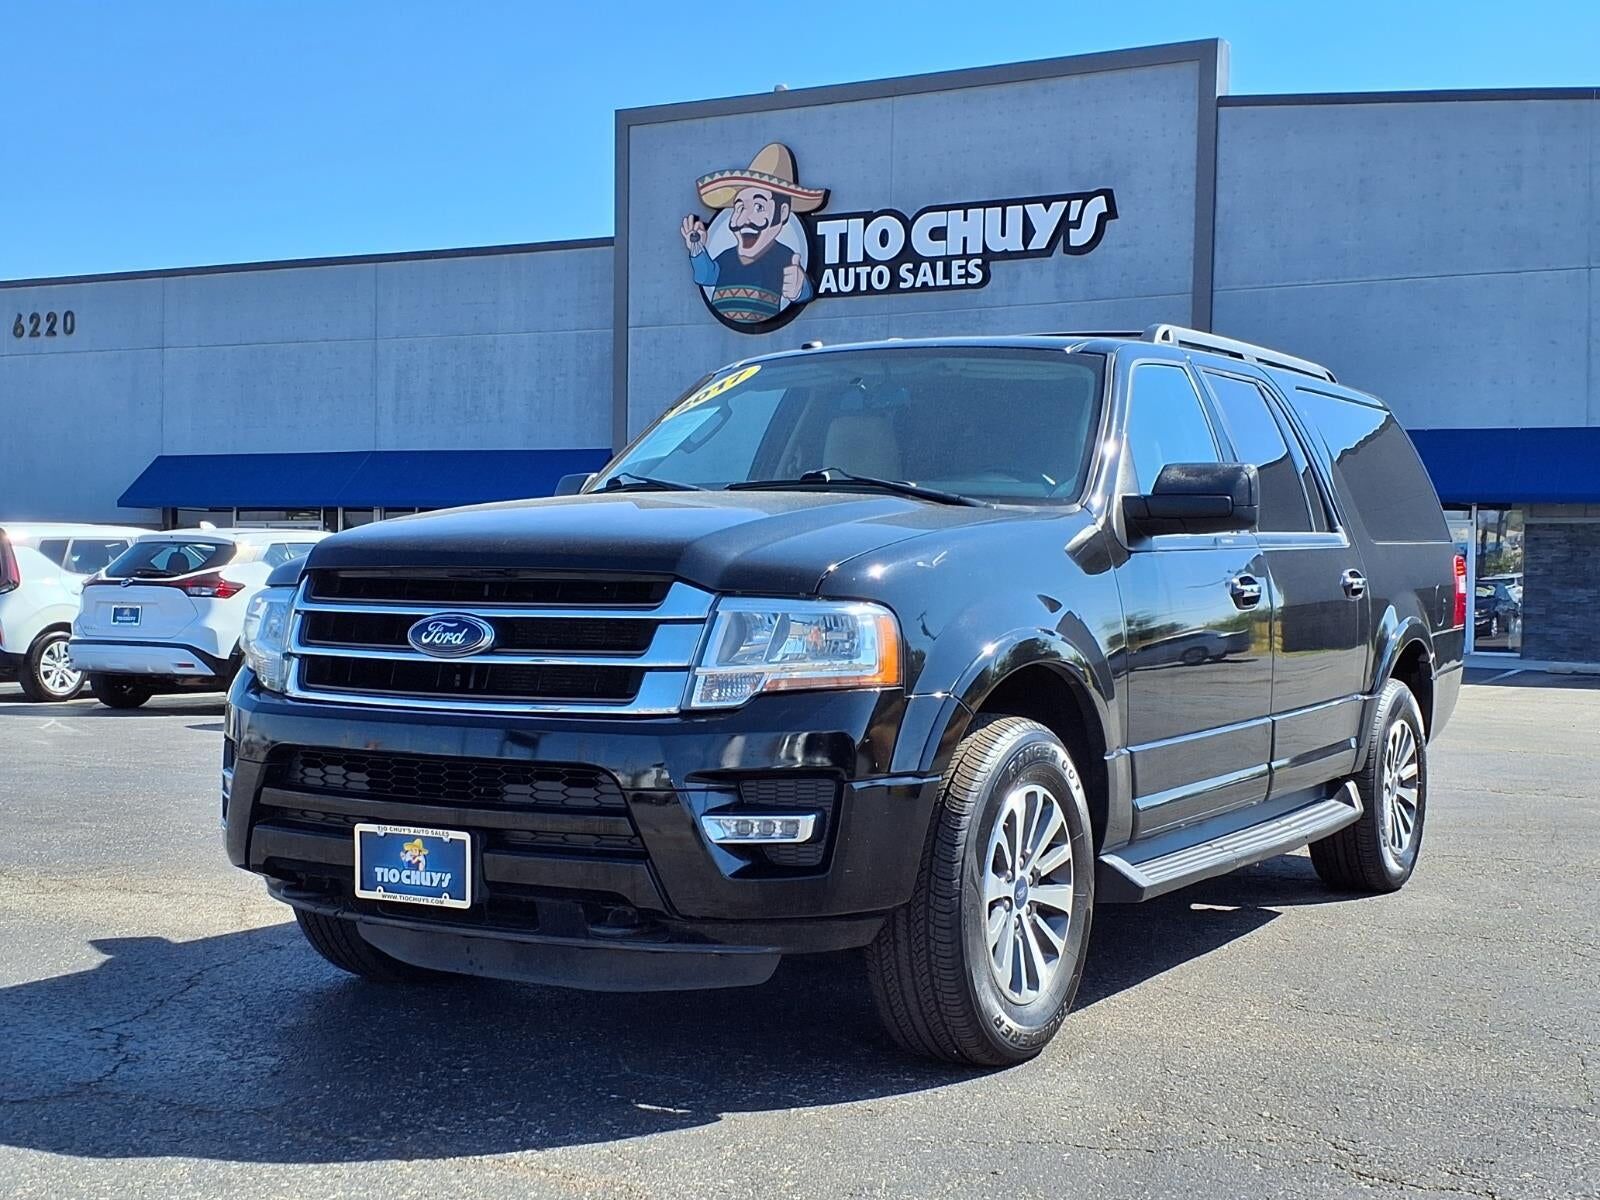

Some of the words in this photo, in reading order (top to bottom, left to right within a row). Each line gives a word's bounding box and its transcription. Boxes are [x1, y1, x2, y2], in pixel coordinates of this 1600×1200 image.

[817, 215, 906, 264] TIO
[911, 195, 1108, 257] CHUY'S
[819, 265, 891, 294] AUTO
[899, 259, 983, 289] SALES
[13, 310, 75, 338] 6220
[421, 621, 468, 645] Ford
[374, 867, 400, 883] TIO
[401, 870, 452, 888] CHUY'S
